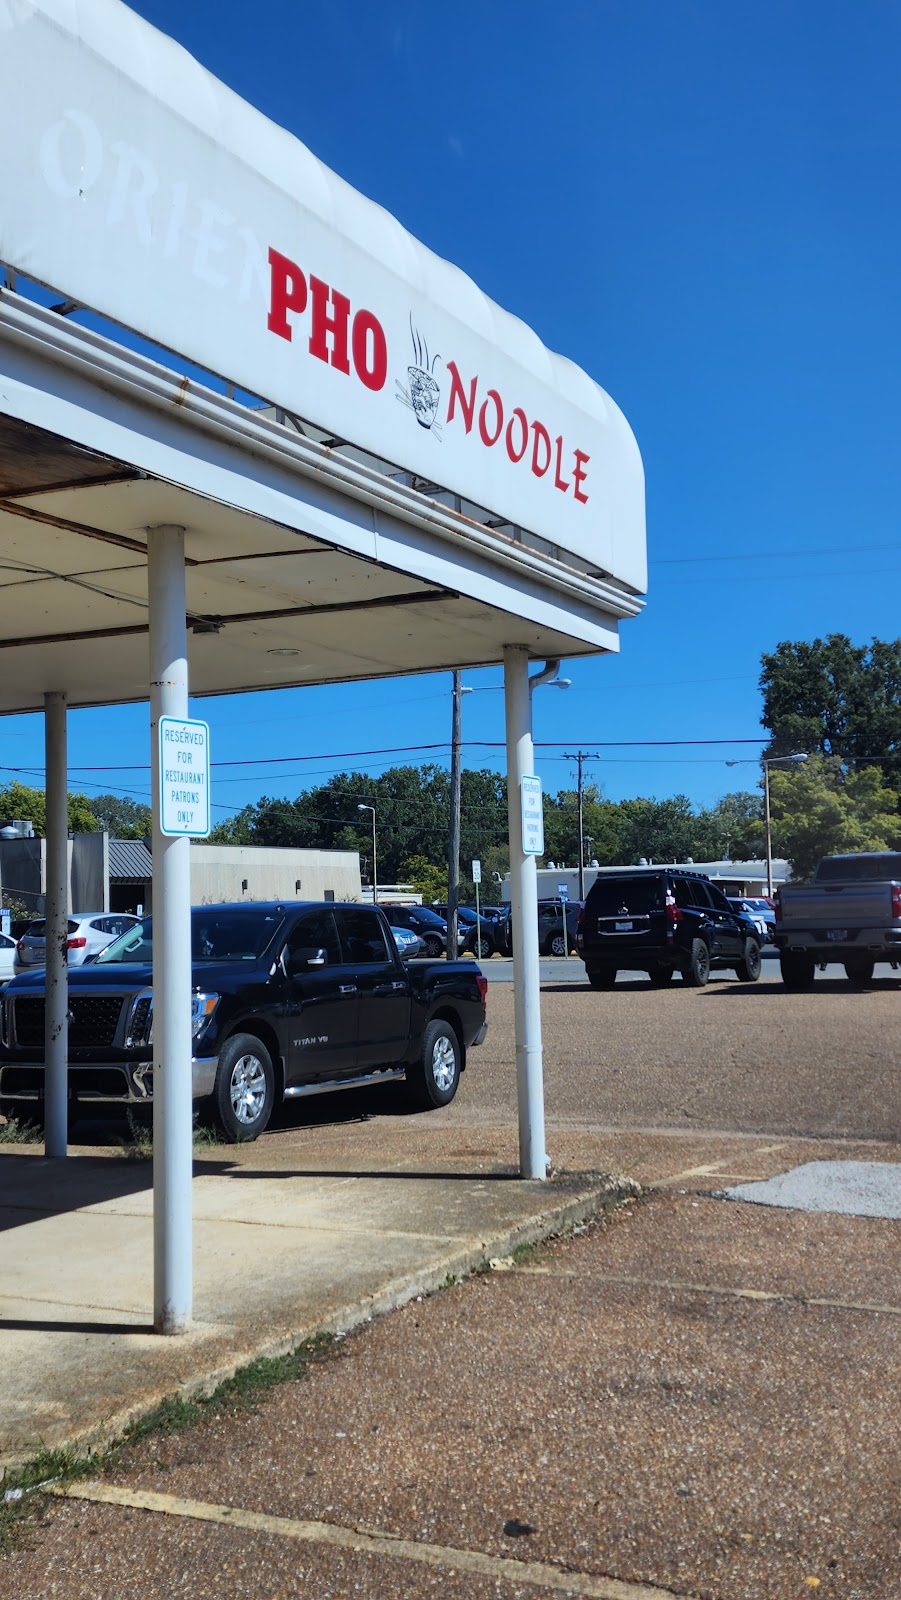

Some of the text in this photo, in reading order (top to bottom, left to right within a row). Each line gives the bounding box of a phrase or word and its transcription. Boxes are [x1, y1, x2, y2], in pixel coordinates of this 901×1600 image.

[266, 245, 591, 505] PHO NOODLE
[165, 729, 204, 746] RESERVED
[177, 751, 193, 764] FOR
[165, 769, 205, 785] RESTAURANT
[171, 790, 200, 804] PATRONS
[177, 810, 194, 823] ONLY
[293, 1037, 316, 1046] TITAN
